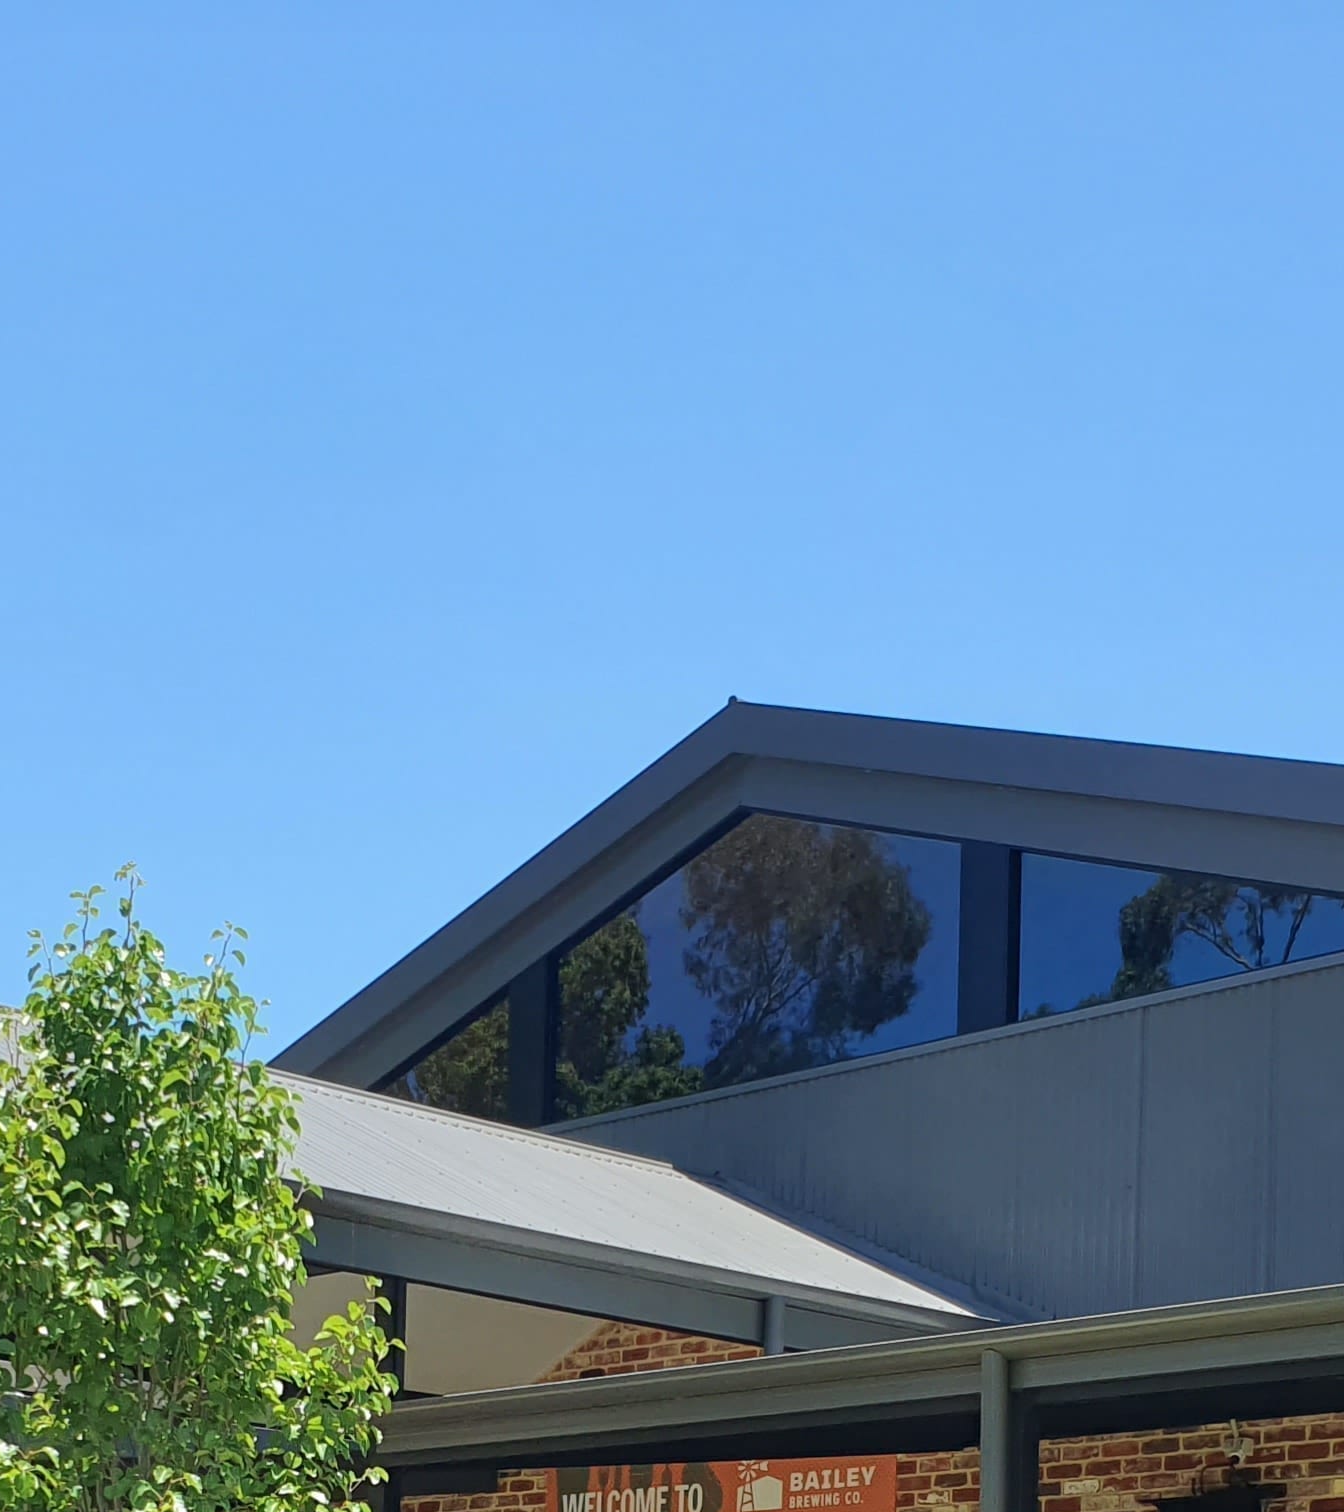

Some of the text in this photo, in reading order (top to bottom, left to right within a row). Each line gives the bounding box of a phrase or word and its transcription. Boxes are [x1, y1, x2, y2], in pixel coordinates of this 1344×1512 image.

[790, 1465, 876, 1492] BAILEY
[789, 1491, 864, 1509] BREWING CO.
